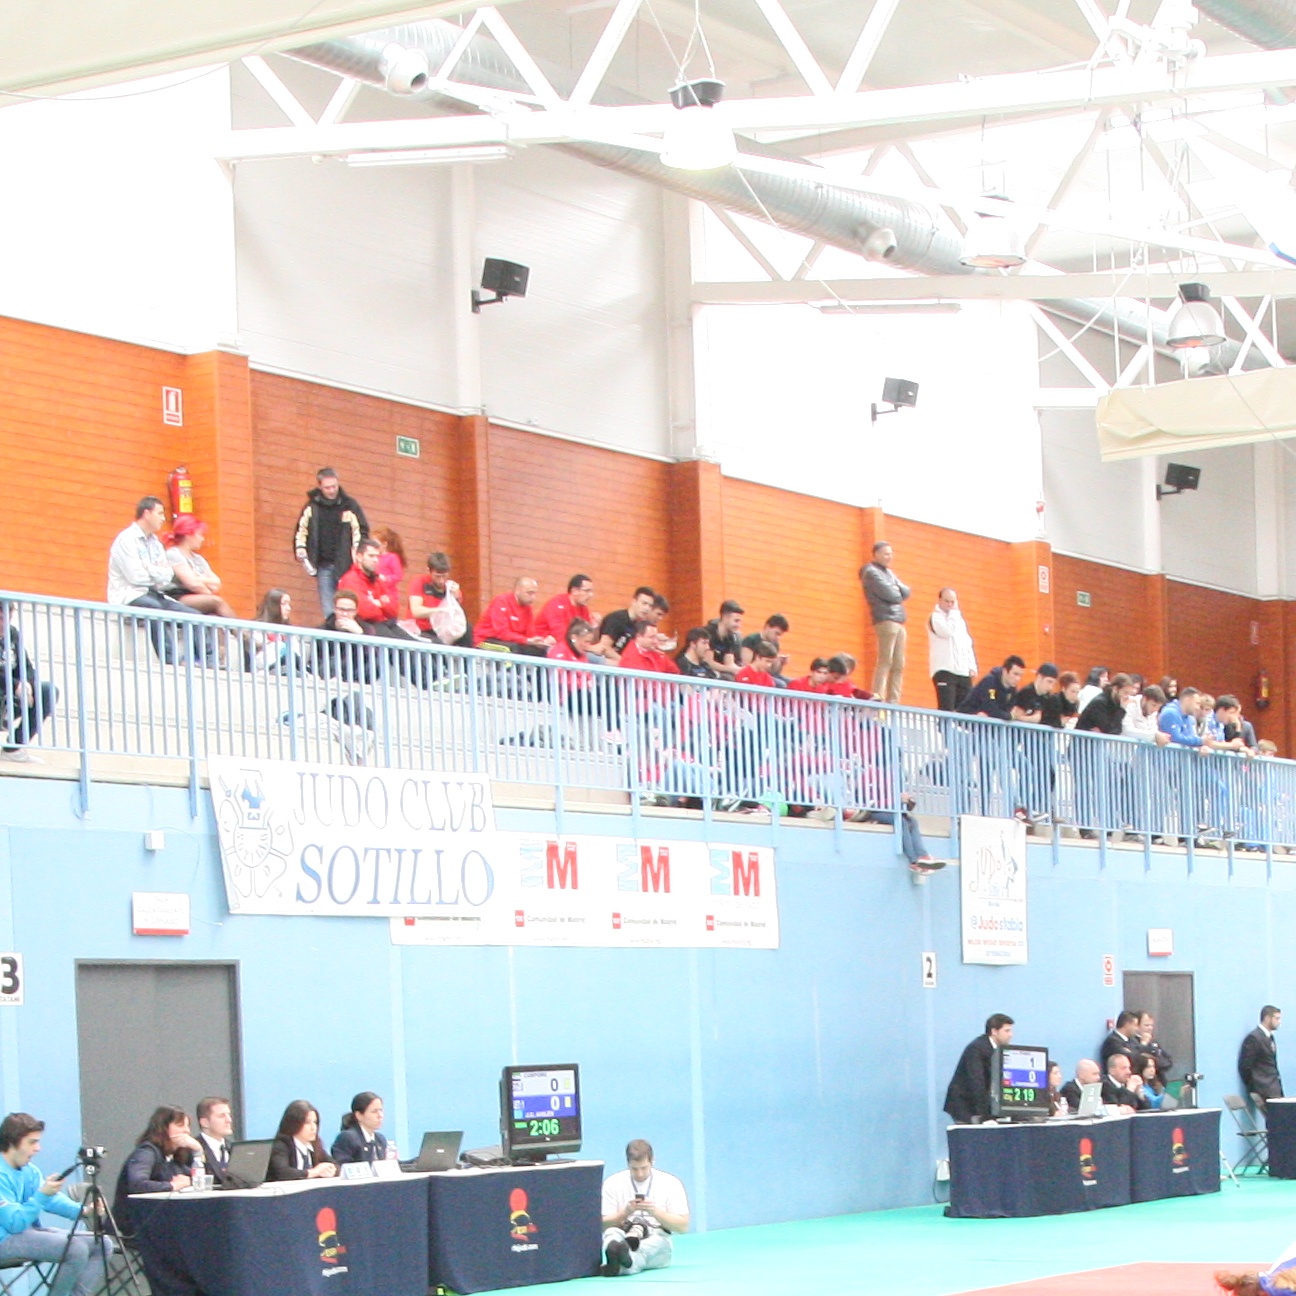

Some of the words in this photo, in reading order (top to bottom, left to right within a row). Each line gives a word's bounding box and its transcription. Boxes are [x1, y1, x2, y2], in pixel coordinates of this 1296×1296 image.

[293, 772, 388, 829] JUDO
[400, 778, 488, 832] CLUB
[295, 842, 495, 907] SOTILLO
[1, 956, 20, 994] 3
[926, 956, 933, 978] 2
[1029, 1057, 1035, 1069] 1
[550, 1077, 559, 1092] 0
[1029, 1071, 1036, 1083] 0
[550, 1095, 561, 1111] 0
[530, 1118, 560, 1137] 2:06
